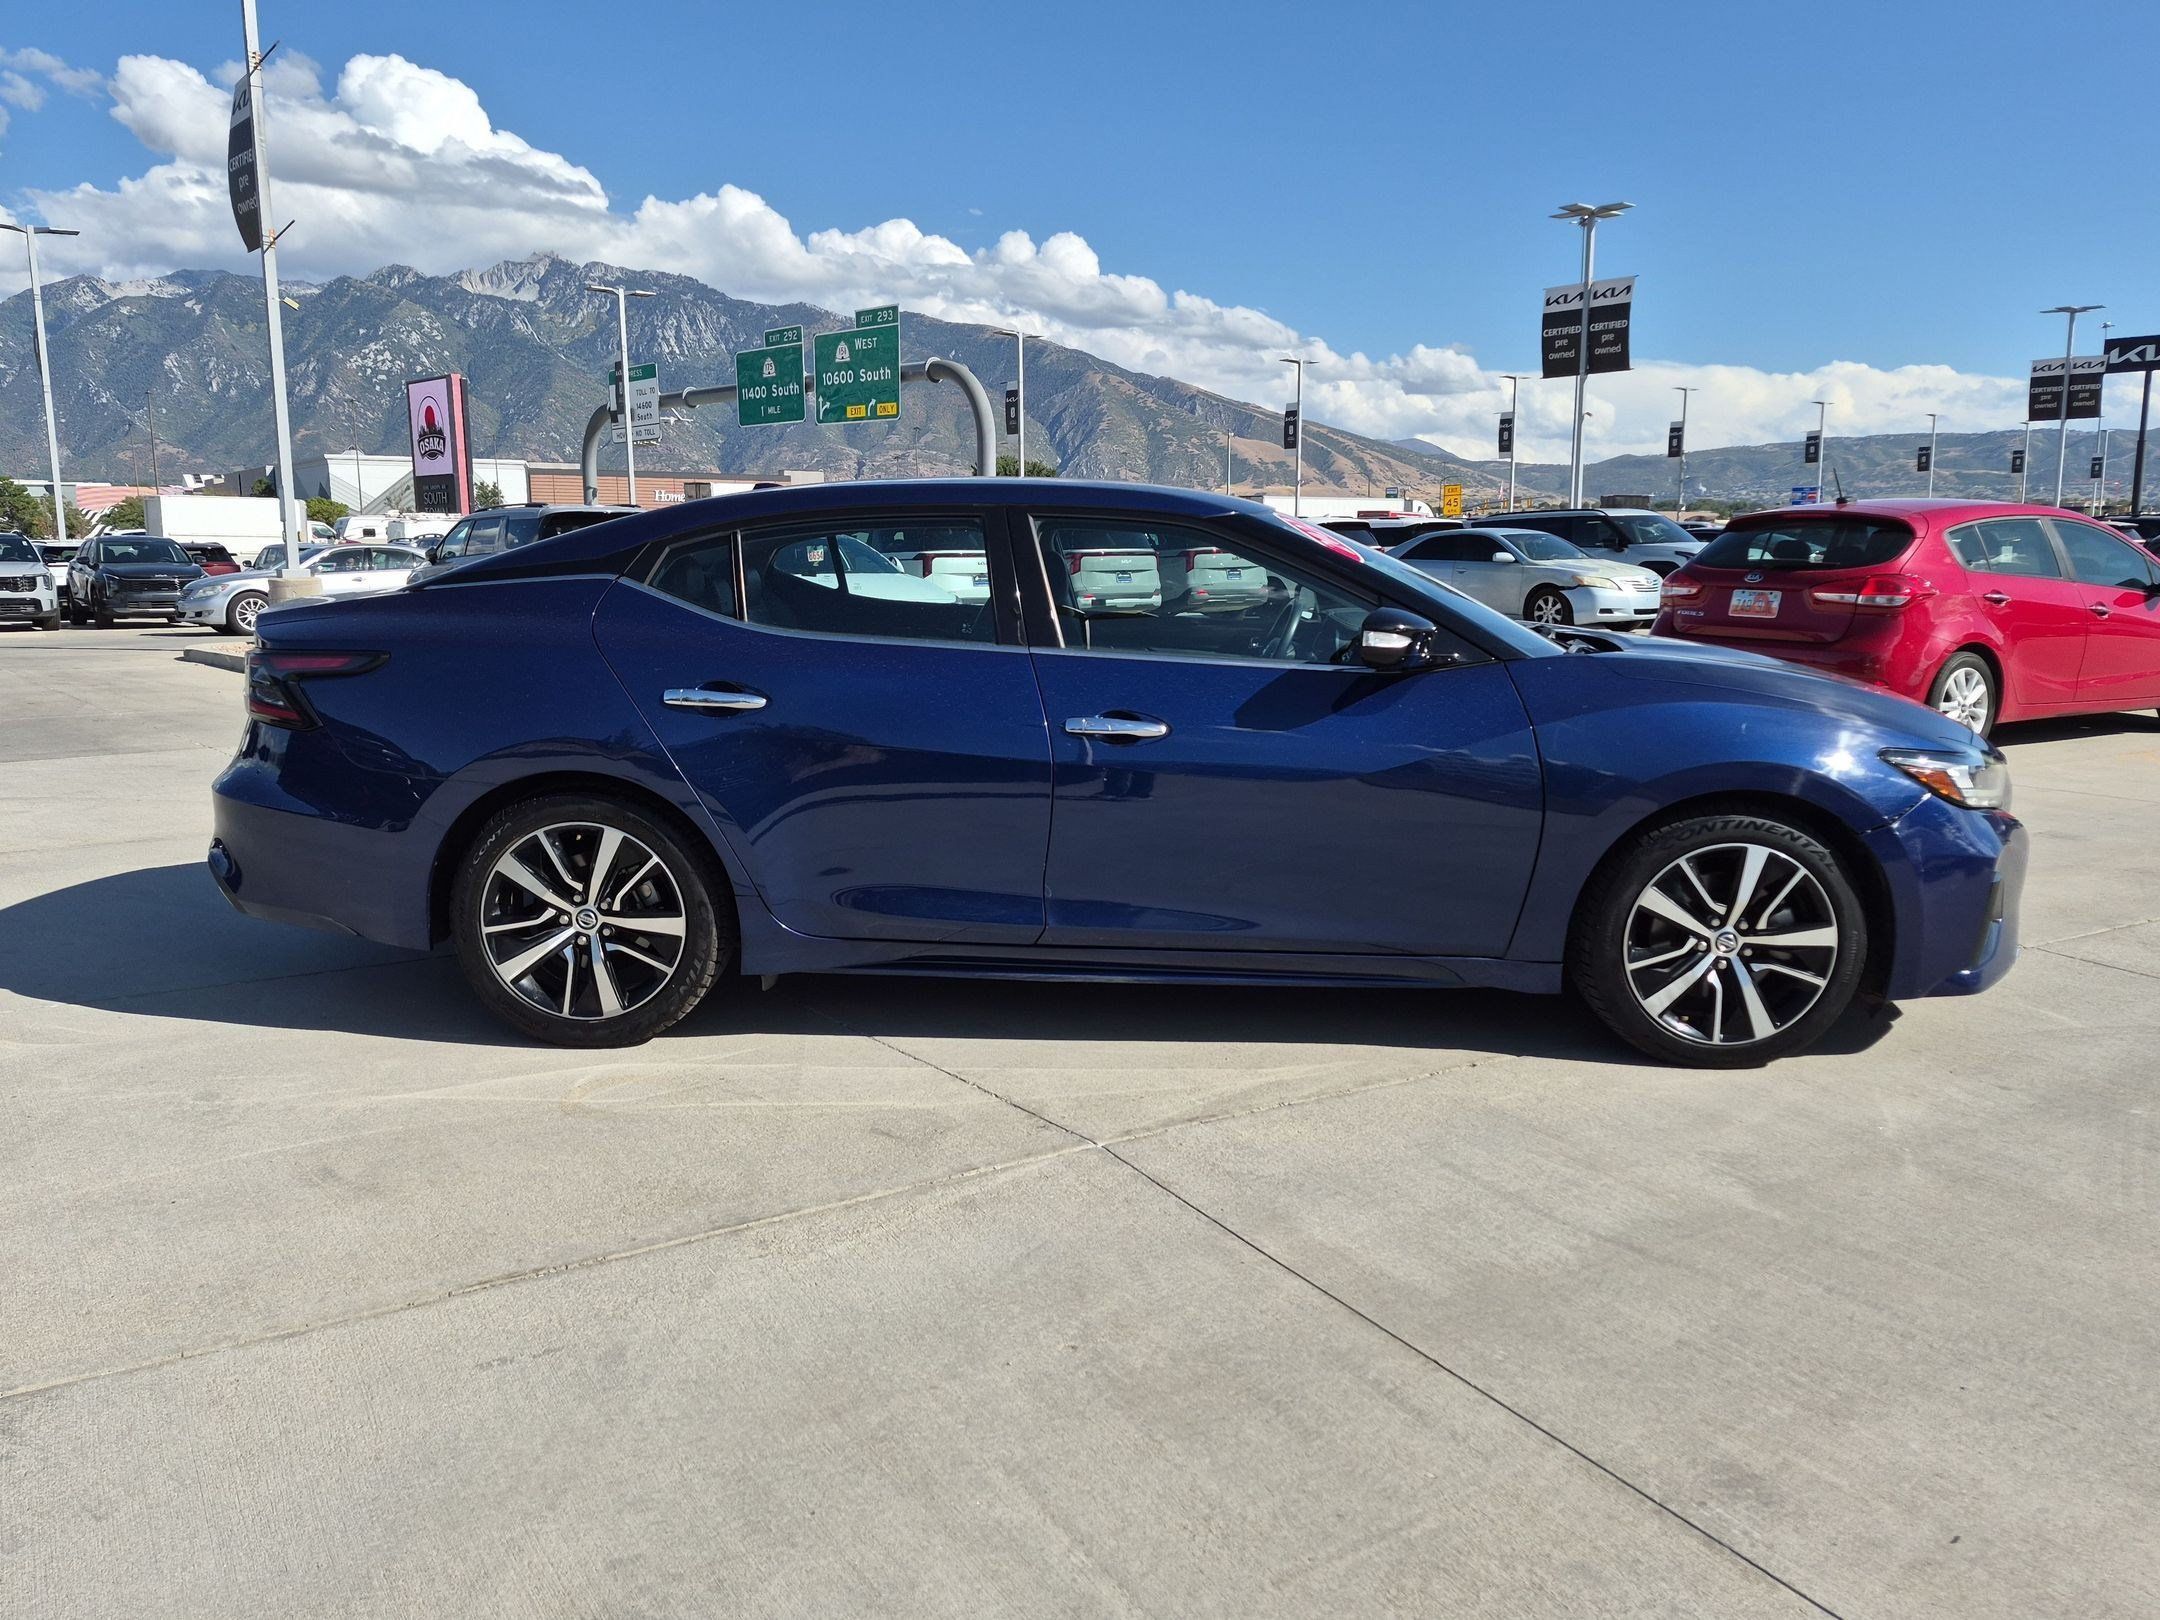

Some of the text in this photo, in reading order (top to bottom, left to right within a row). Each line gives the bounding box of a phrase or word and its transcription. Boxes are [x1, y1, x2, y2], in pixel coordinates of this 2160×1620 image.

[229, 149, 253, 173] CERTIFIE
[238, 173, 249, 192] pre
[237, 192, 257, 215] owned
[1592, 284, 1632, 300] KIA
[1545, 291, 1584, 306] KIA
[860, 309, 893, 324] EXIT 293
[1543, 325, 1582, 337] CERTIFIED
[1589, 319, 1628, 331] CERTIFIED
[769, 330, 798, 342] EXIT 292
[1601, 333, 1615, 343] pre
[854, 337, 878, 350] WEST
[1555, 338, 1569, 349] pre
[1594, 344, 1622, 355] owned
[1548, 348, 1575, 360] owned
[2072, 360, 2106, 370] KIA
[823, 366, 891, 385] 10600 South
[636, 388, 647, 396] TOLL
[742, 382, 800, 400] 11400 South
[2031, 386, 2064, 394] CERTIFIED
[2069, 383, 2102, 391] CERTIFIED
[636, 401, 652, 409] 14600
[767, 405, 781, 414] MILE
[879, 405, 894, 413] ONLY
[637, 413, 653, 421] South
[850, 408, 862, 416] EXIT
[644, 428, 655, 436] TOLL
[420, 437, 444, 454] OSAKA
[424, 491, 448, 505] SOUTH
[654, 489, 685, 502] Home
[1446, 498, 1459, 507] 45
[1660, 818, 1837, 874] ONTINENTAL
